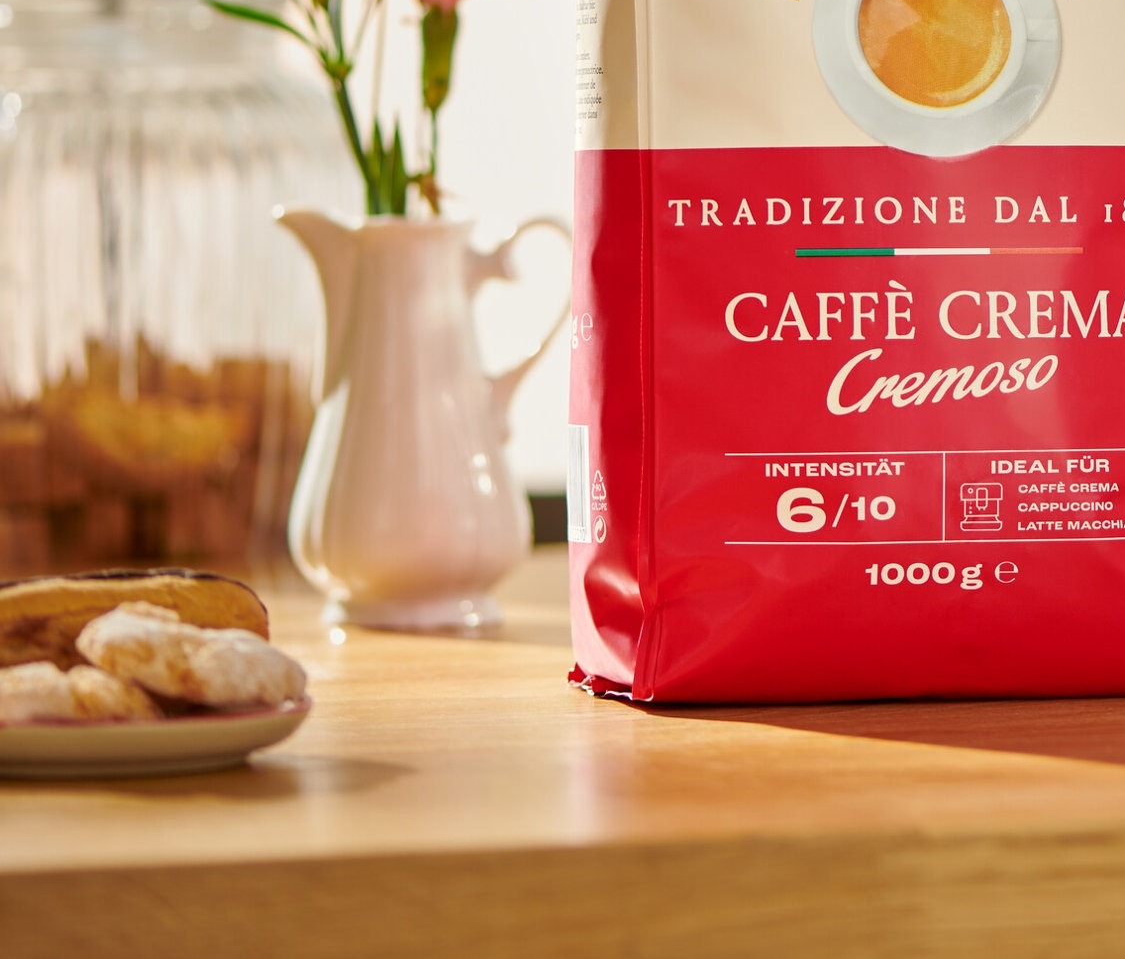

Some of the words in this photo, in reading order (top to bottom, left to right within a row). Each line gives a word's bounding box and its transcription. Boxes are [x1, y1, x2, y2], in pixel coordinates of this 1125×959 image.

[668, 196, 967, 227] TRADIZIONE
[994, 195, 1079, 224] DAL
[724, 279, 916, 343] CAFFÈ
[826, 347, 1060, 417] Cremoso
[765, 457, 905, 478] INTENSITÄT
[991, 458, 1059, 475] IDEAL
[1066, 455, 1111, 474] FÜR
[1018, 480, 1066, 495] CAFFÈ
[1070, 481, 1120, 494] CREMA
[1017, 501, 1114, 513] CAPPUCCINO
[1017, 519, 1064, 532] LATTE
